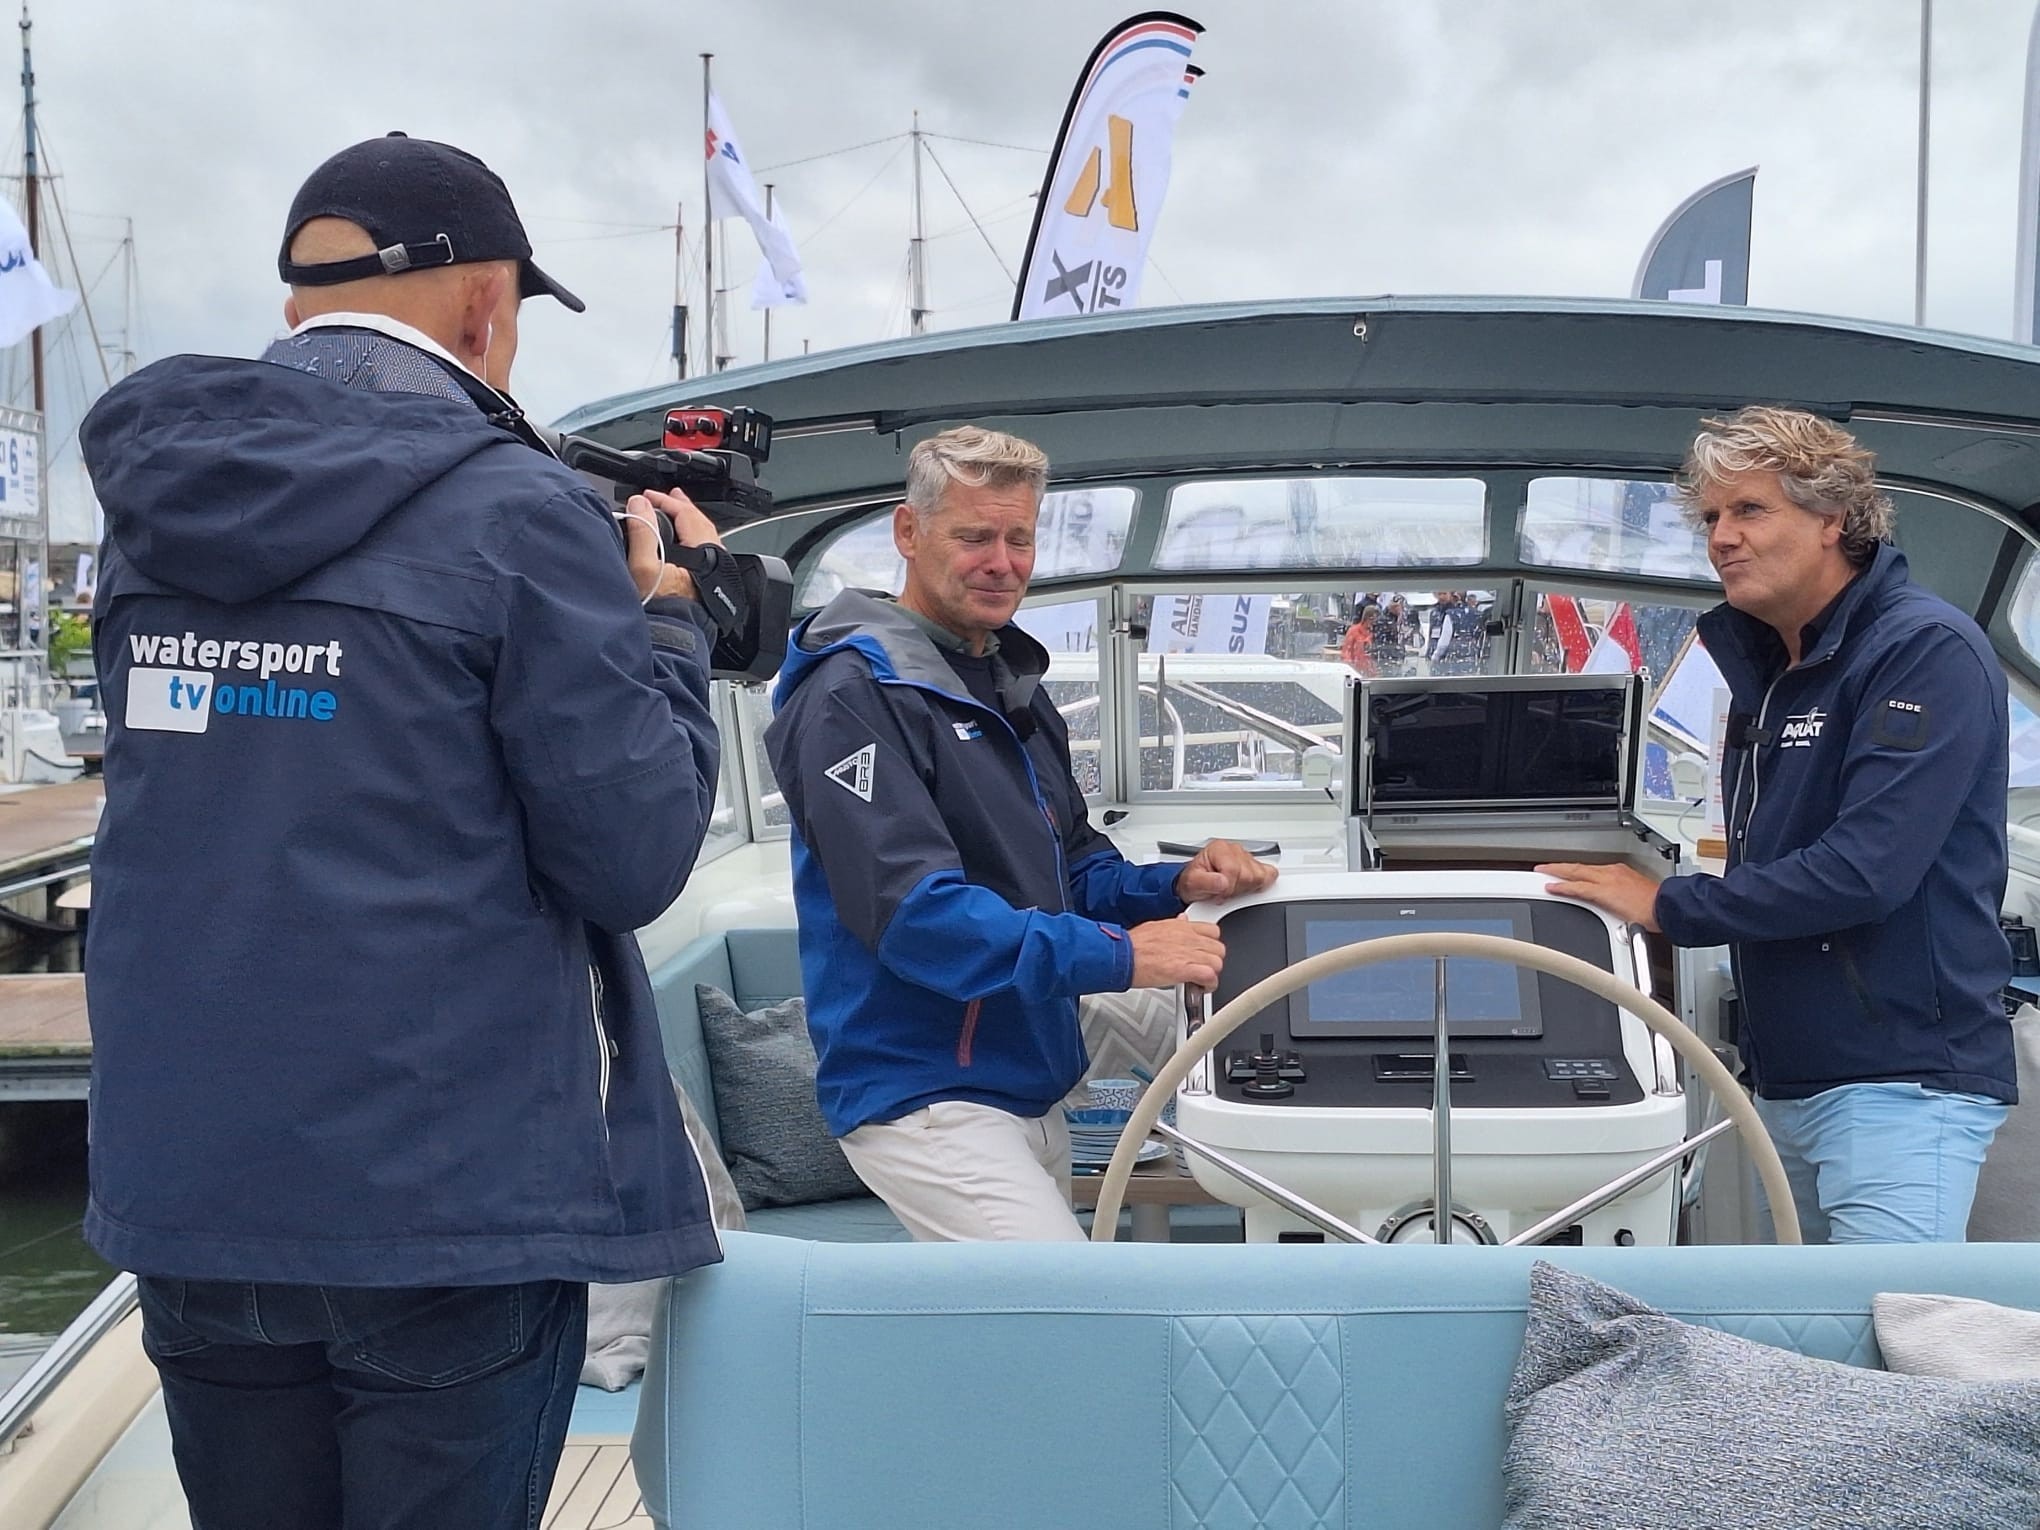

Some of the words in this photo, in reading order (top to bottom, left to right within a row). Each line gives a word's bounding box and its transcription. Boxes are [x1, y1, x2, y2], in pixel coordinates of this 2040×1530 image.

[1098, 265, 1127, 308] TS
[10, 438, 18, 475] 6
[1229, 595, 1252, 653] SUZ
[129, 632, 343, 680] watersport
[168, 675, 207, 711] tv
[214, 680, 338, 721] online
[1889, 700, 1921, 712] CODE
